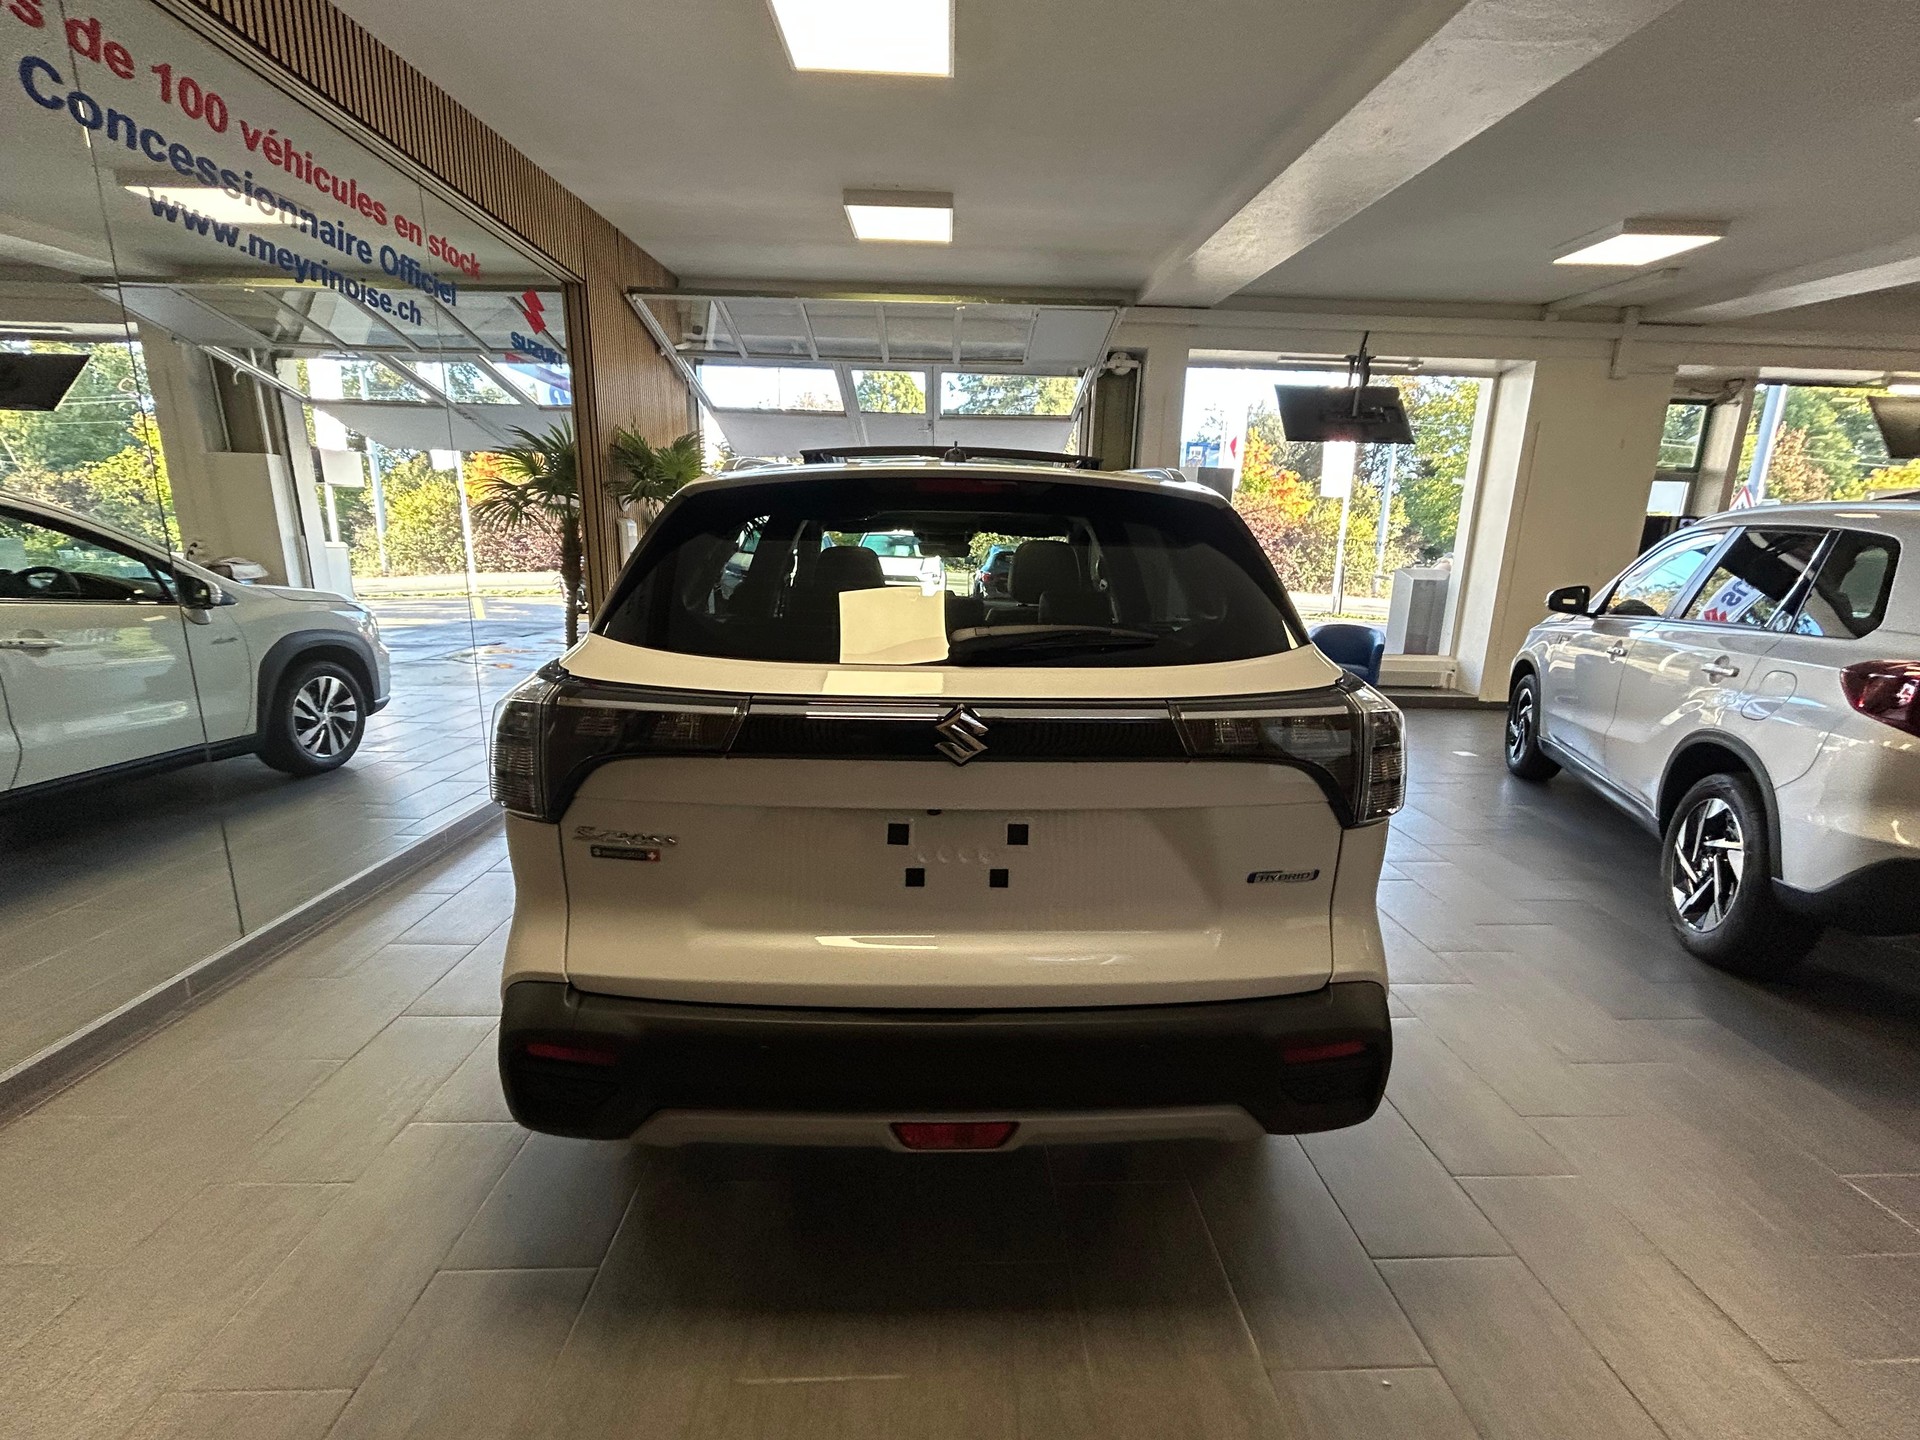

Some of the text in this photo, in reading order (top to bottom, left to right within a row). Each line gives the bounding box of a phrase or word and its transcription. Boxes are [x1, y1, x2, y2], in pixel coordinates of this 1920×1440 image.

[18, 56, 457, 306] Concessionnaire Officiel
[64, 17, 135, 79] de
[151, 63, 229, 133] 100
[239, 119, 388, 226] véhicules
[394, 214, 422, 247] en
[428, 234, 480, 280] stock
[148, 187, 422, 326] www.meyrinoise.ch
